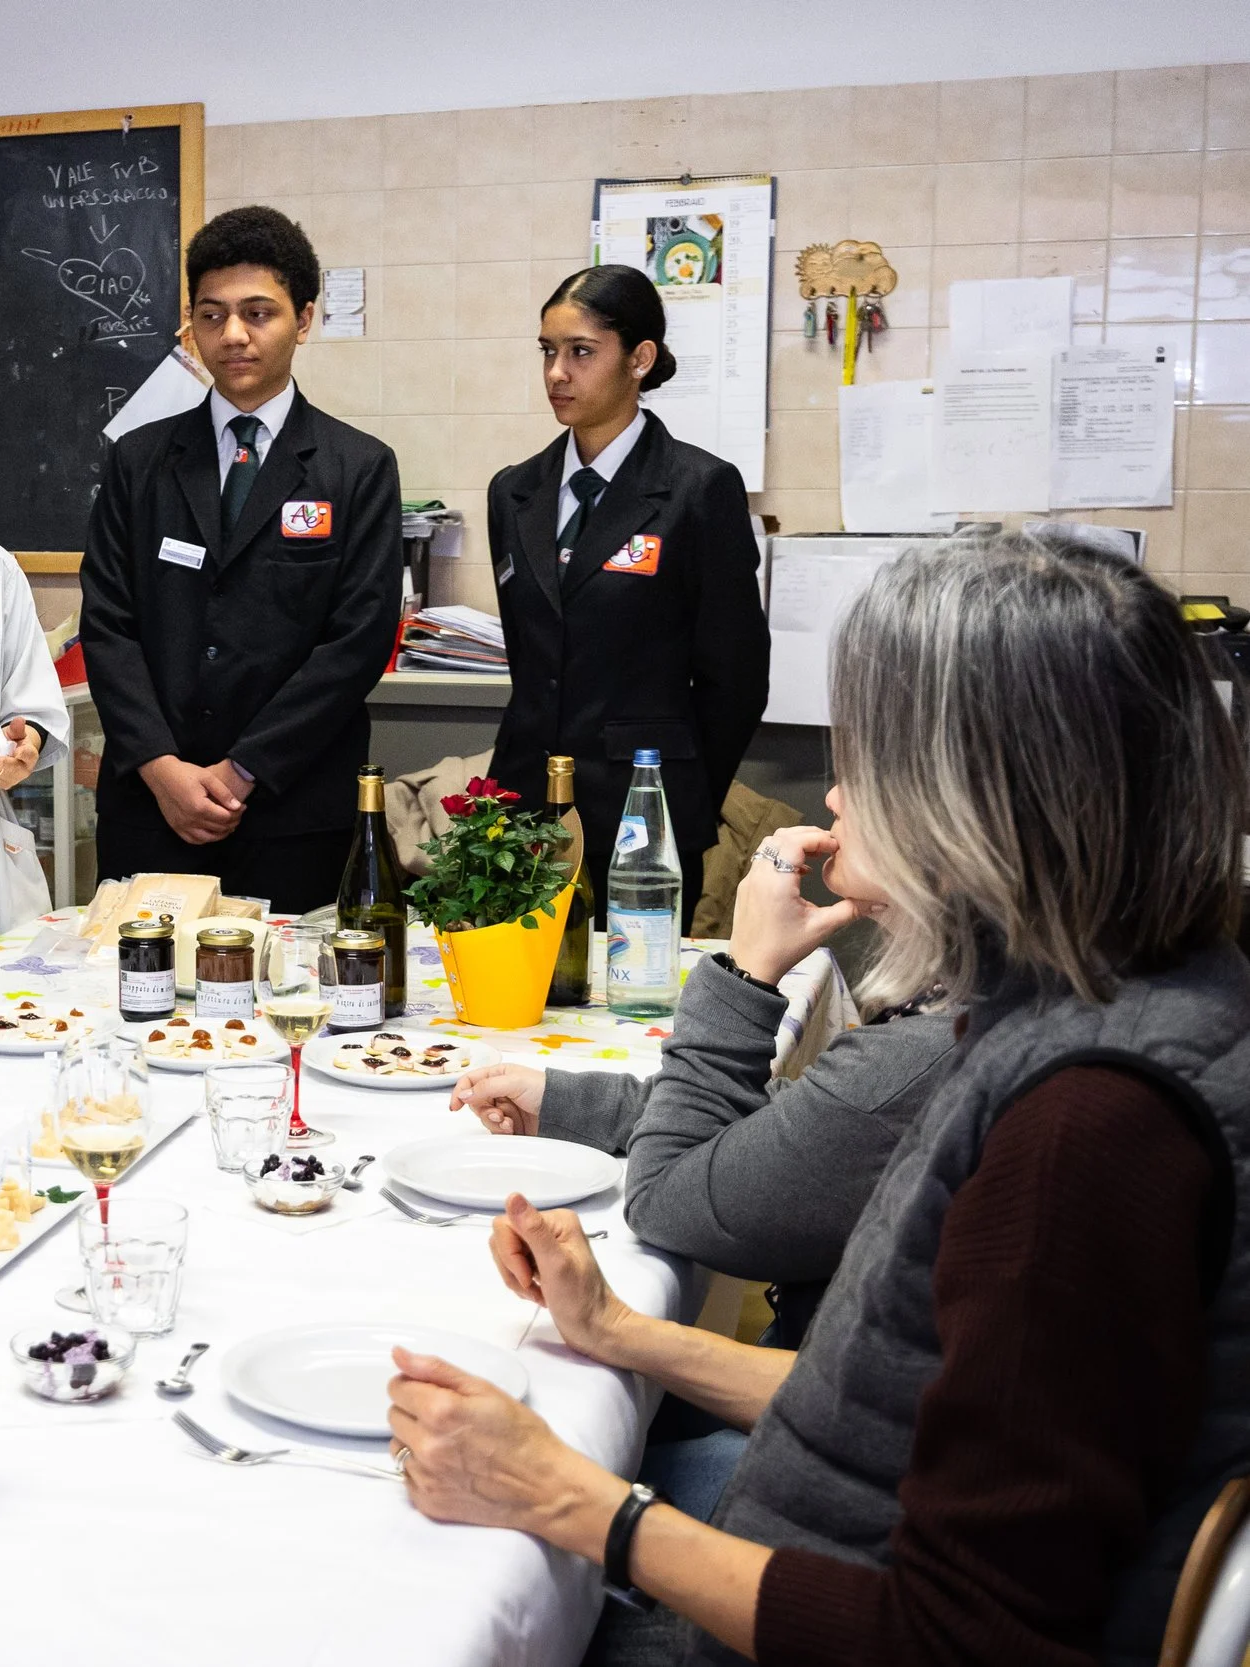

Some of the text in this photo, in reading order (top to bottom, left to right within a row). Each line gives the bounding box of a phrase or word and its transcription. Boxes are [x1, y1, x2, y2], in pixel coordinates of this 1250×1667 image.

[47, 155, 160, 189] VALE TVB
[75, 274, 134, 295] CIAO
